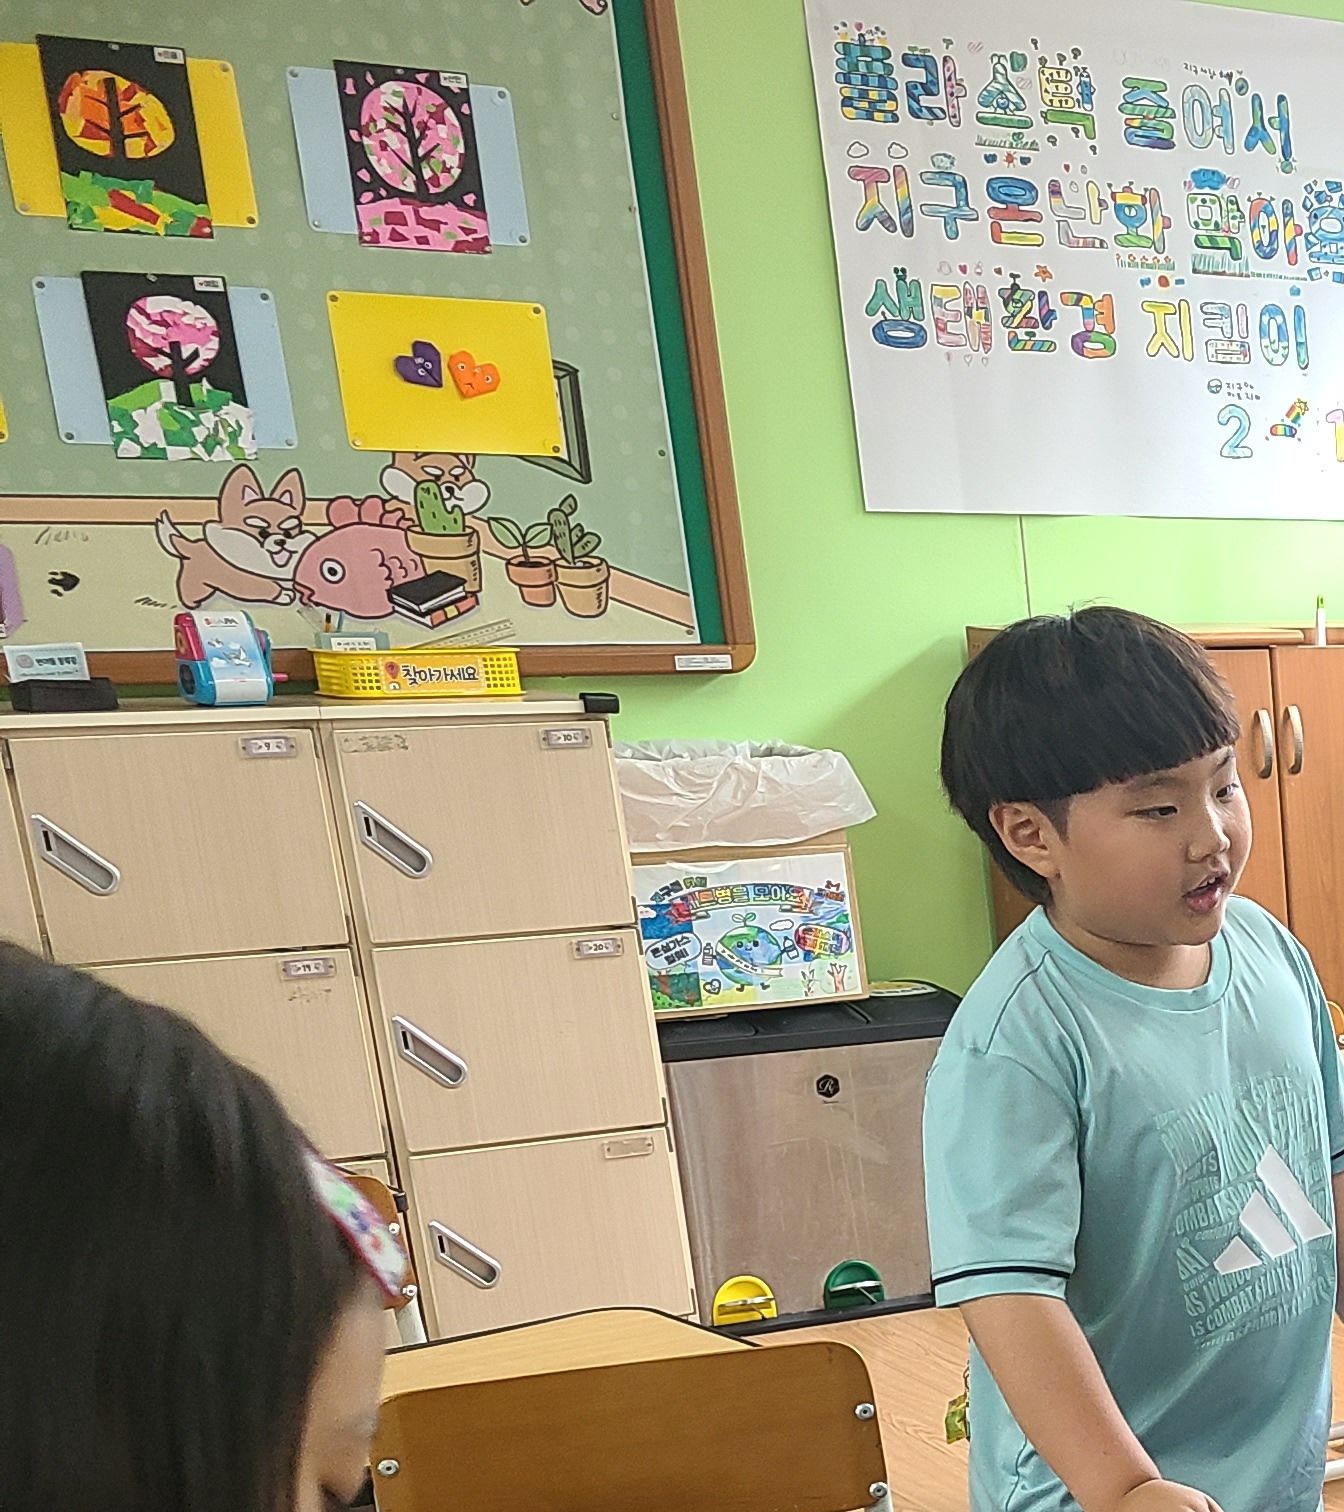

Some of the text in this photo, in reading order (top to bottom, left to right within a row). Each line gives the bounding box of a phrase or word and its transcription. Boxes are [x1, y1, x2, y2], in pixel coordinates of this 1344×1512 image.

[1119, 77, 1293, 160] 줄여서
[847, 164, 1172, 253] 지구온난화
[866, 277, 1310, 370] 생태환경 지킴이
[401, 663, 479, 686] 찾아가세요
